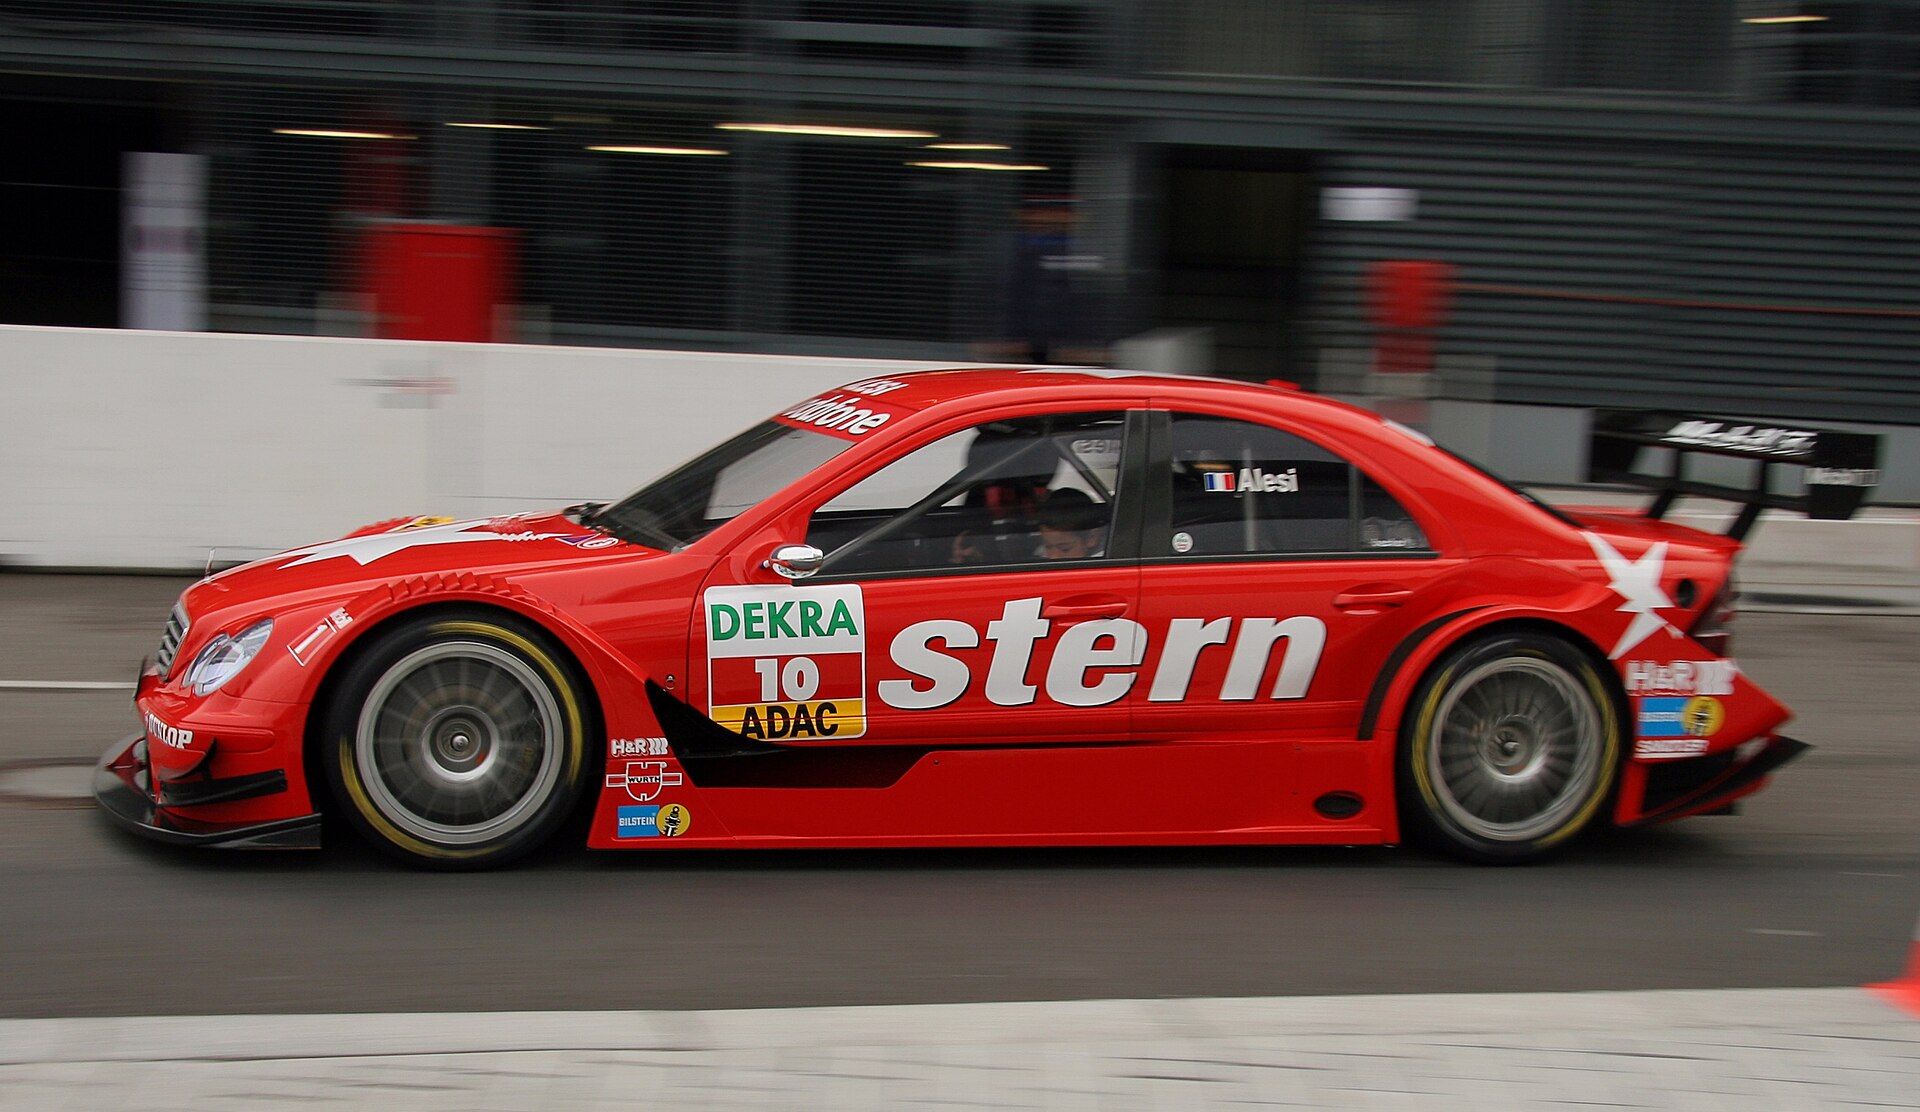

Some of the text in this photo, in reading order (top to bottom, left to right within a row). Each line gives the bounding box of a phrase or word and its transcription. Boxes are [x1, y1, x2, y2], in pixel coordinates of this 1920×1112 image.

[1237, 468, 1299, 492] Alesi
[710, 598, 859, 641] DEKRA
[877, 596, 1328, 709] stern
[754, 656, 820, 701] 10
[740, 702, 839, 739] ADAC
[611, 738, 648, 757] H&R
[619, 817, 655, 826] BILSTEIN
